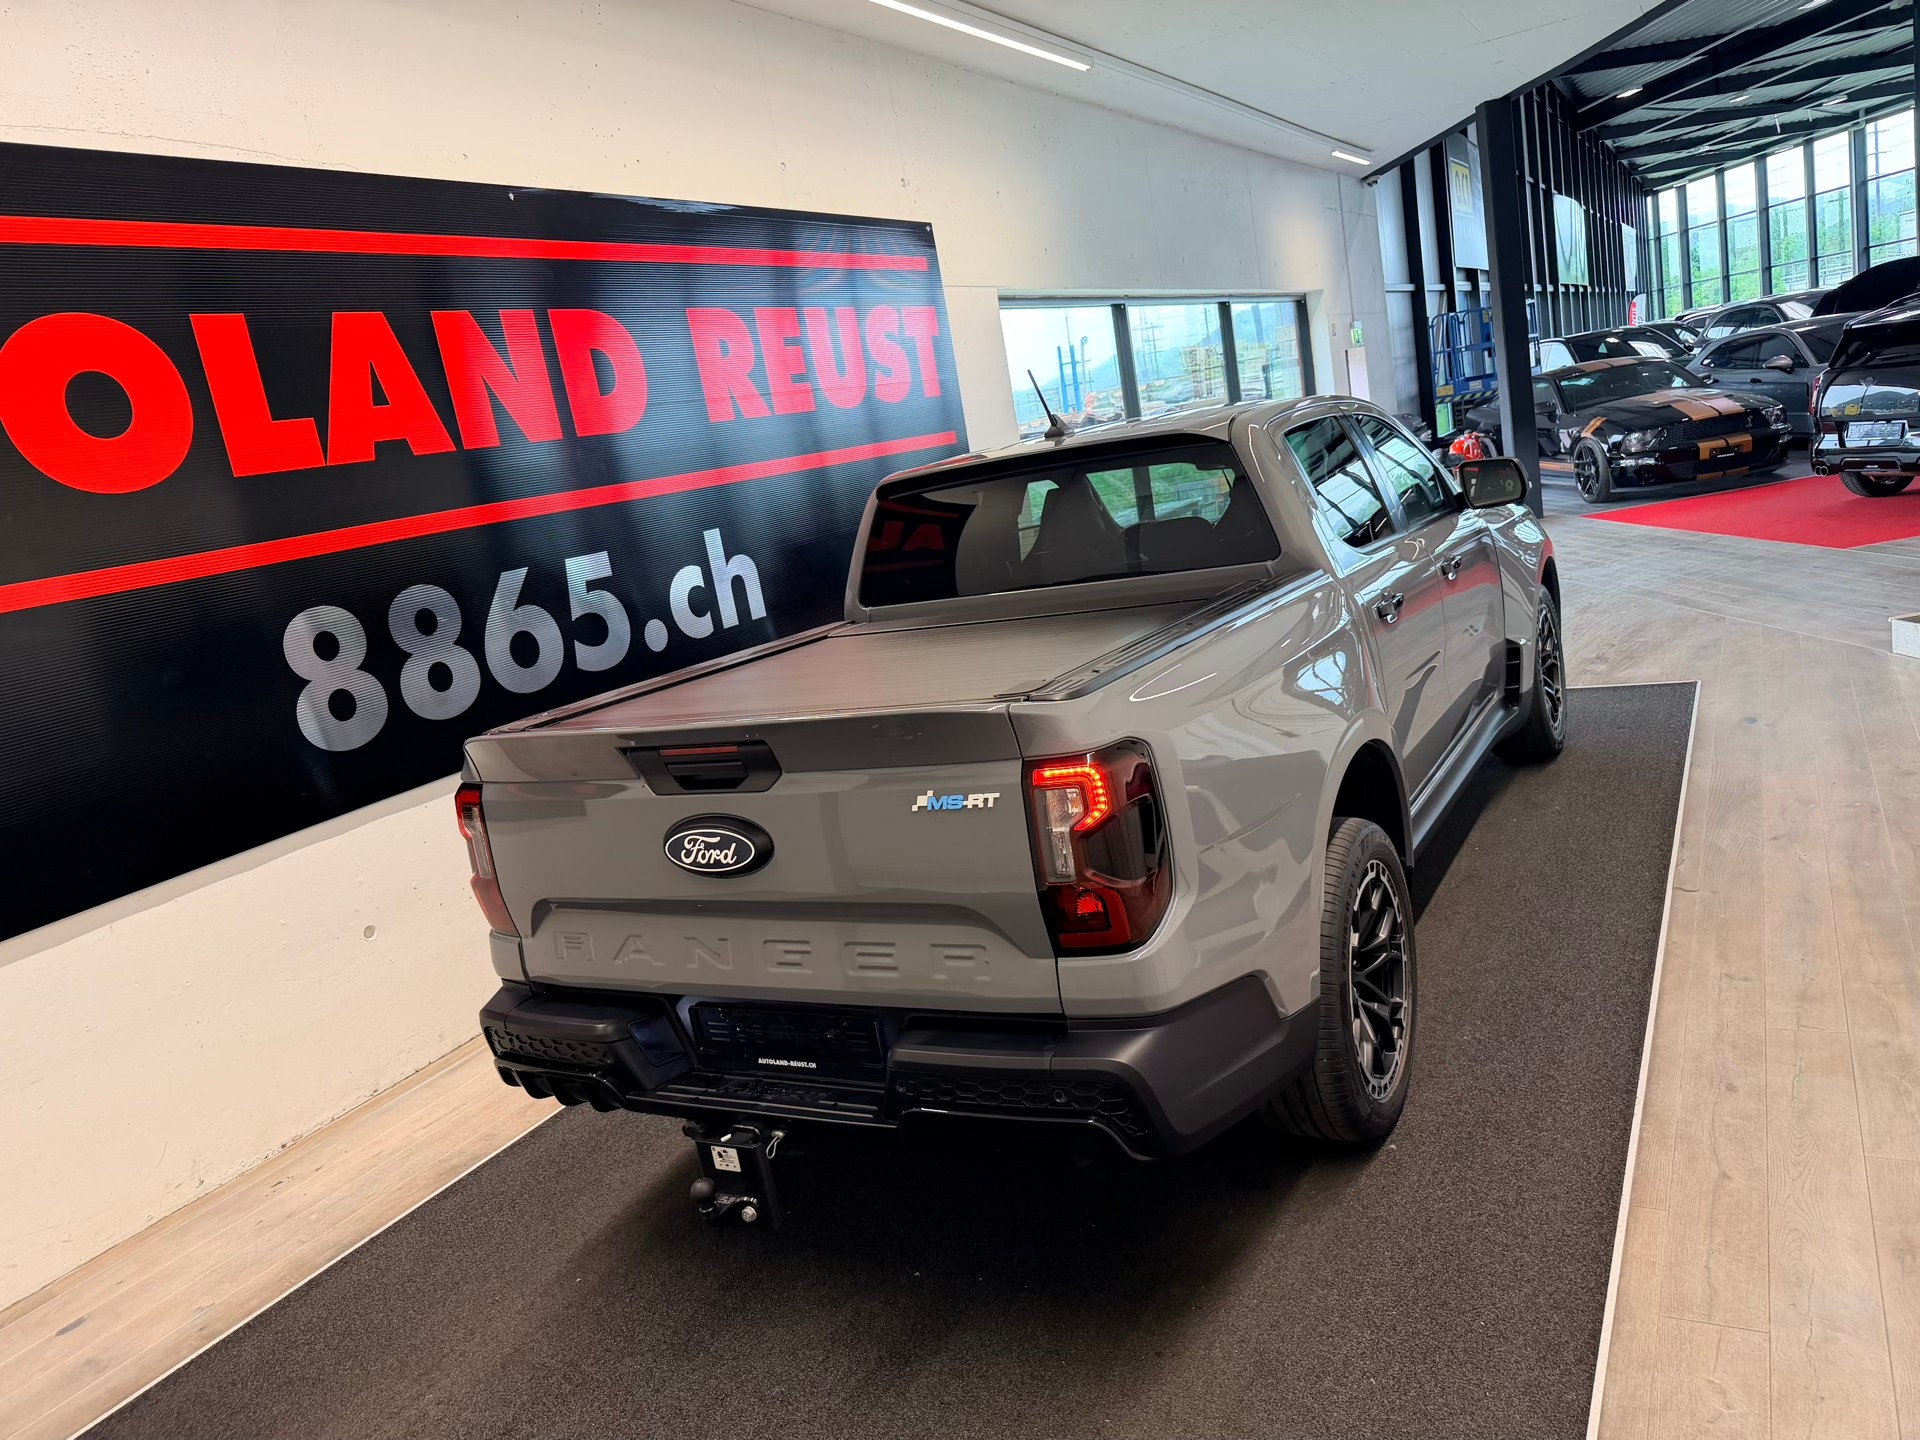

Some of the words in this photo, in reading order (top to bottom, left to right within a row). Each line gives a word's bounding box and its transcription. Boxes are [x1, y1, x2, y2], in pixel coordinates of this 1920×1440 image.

[0, 308, 649, 494] OLAND
[685, 305, 942, 423] REUST
[283, 528, 767, 751] 8865.ch
[680, 835, 737, 865] Ford
[553, 931, 992, 982] RANGER
[758, 1057, 817, 1069] AUTOLAND-REUST.CH
